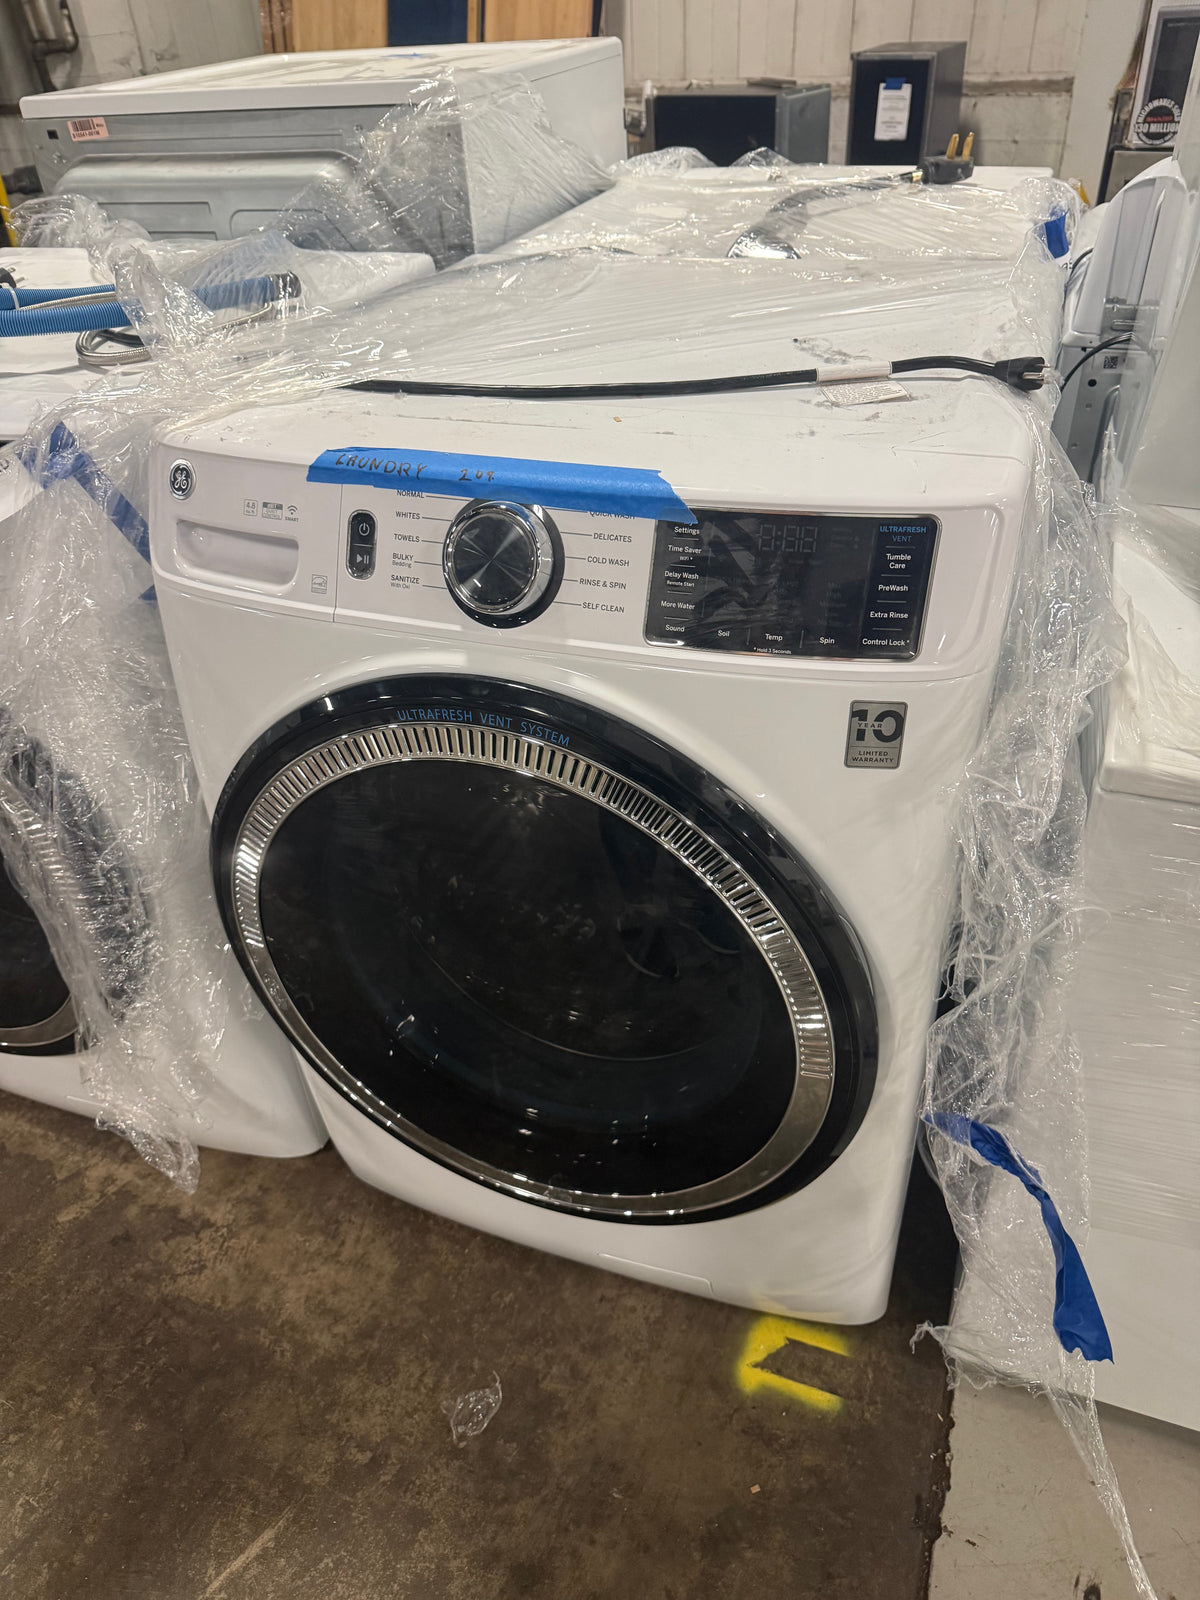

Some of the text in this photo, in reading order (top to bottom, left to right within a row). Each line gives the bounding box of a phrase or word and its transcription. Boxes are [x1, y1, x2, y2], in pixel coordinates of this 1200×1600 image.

[335, 453, 427, 479] LAUNDRY
[397, 490, 424, 498] NORMAL
[396, 511, 420, 519] WHITES
[674, 526, 700, 534] Settings
[394, 533, 419, 542] TOWELS
[593, 532, 632, 542] DELICATES
[684, 546, 702, 554] Saver
[587, 556, 630, 567] COLD WASH
[391, 574, 420, 584] SANITIZE
[664, 570, 681, 579] Delay
[580, 578, 601, 587] RINSE
[582, 602, 625, 613] SELF CLEAN
[677, 602, 696, 610] Water
[889, 611, 909, 619] Rinse
[665, 624, 685, 632] Sound
[765, 633, 783, 642] Temp
[862, 638, 888, 646] Control
[397, 708, 571, 748] ULTRAFRESH VENT SYSTEM
[851, 709, 905, 743] 10
